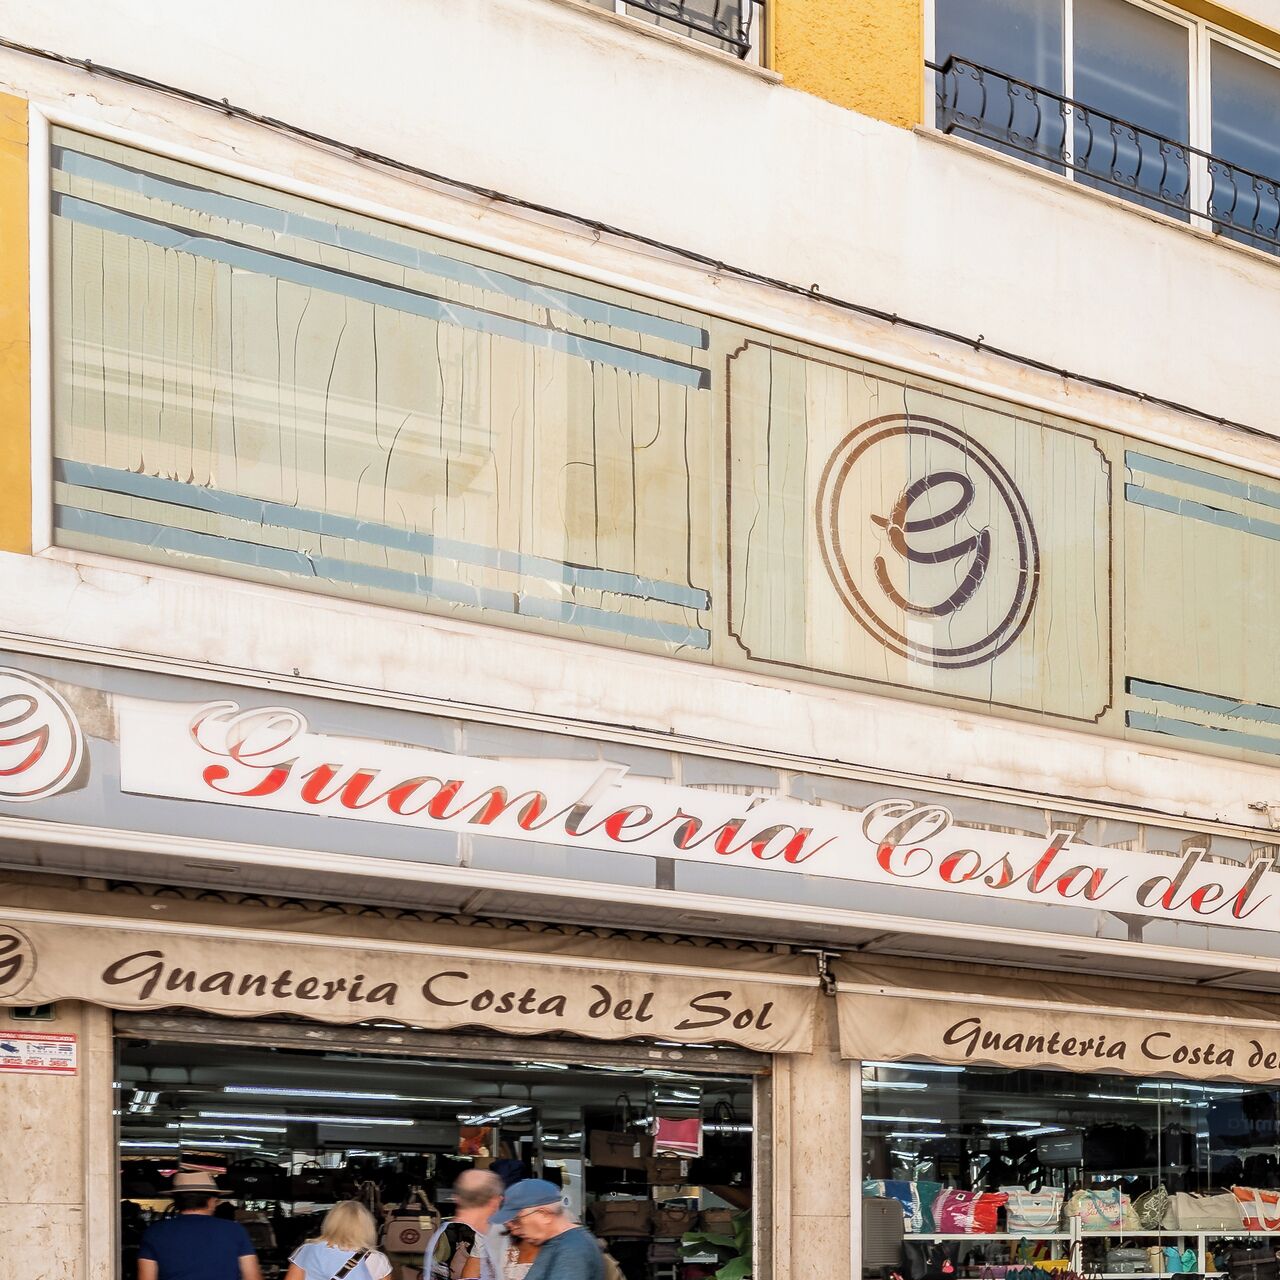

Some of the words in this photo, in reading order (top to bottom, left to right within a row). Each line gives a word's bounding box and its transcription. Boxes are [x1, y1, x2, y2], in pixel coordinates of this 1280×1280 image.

[861, 798, 1128, 902] Costa
[1136, 847, 1273, 919] del
[101, 950, 397, 1008] Guanteria
[421, 970, 568, 1018] Costa
[588, 984, 653, 1023] del
[676, 990, 774, 1032] Sol
[943, 1017, 1126, 1060] Guanteria
[1140, 1031, 1234, 1067] Costa
